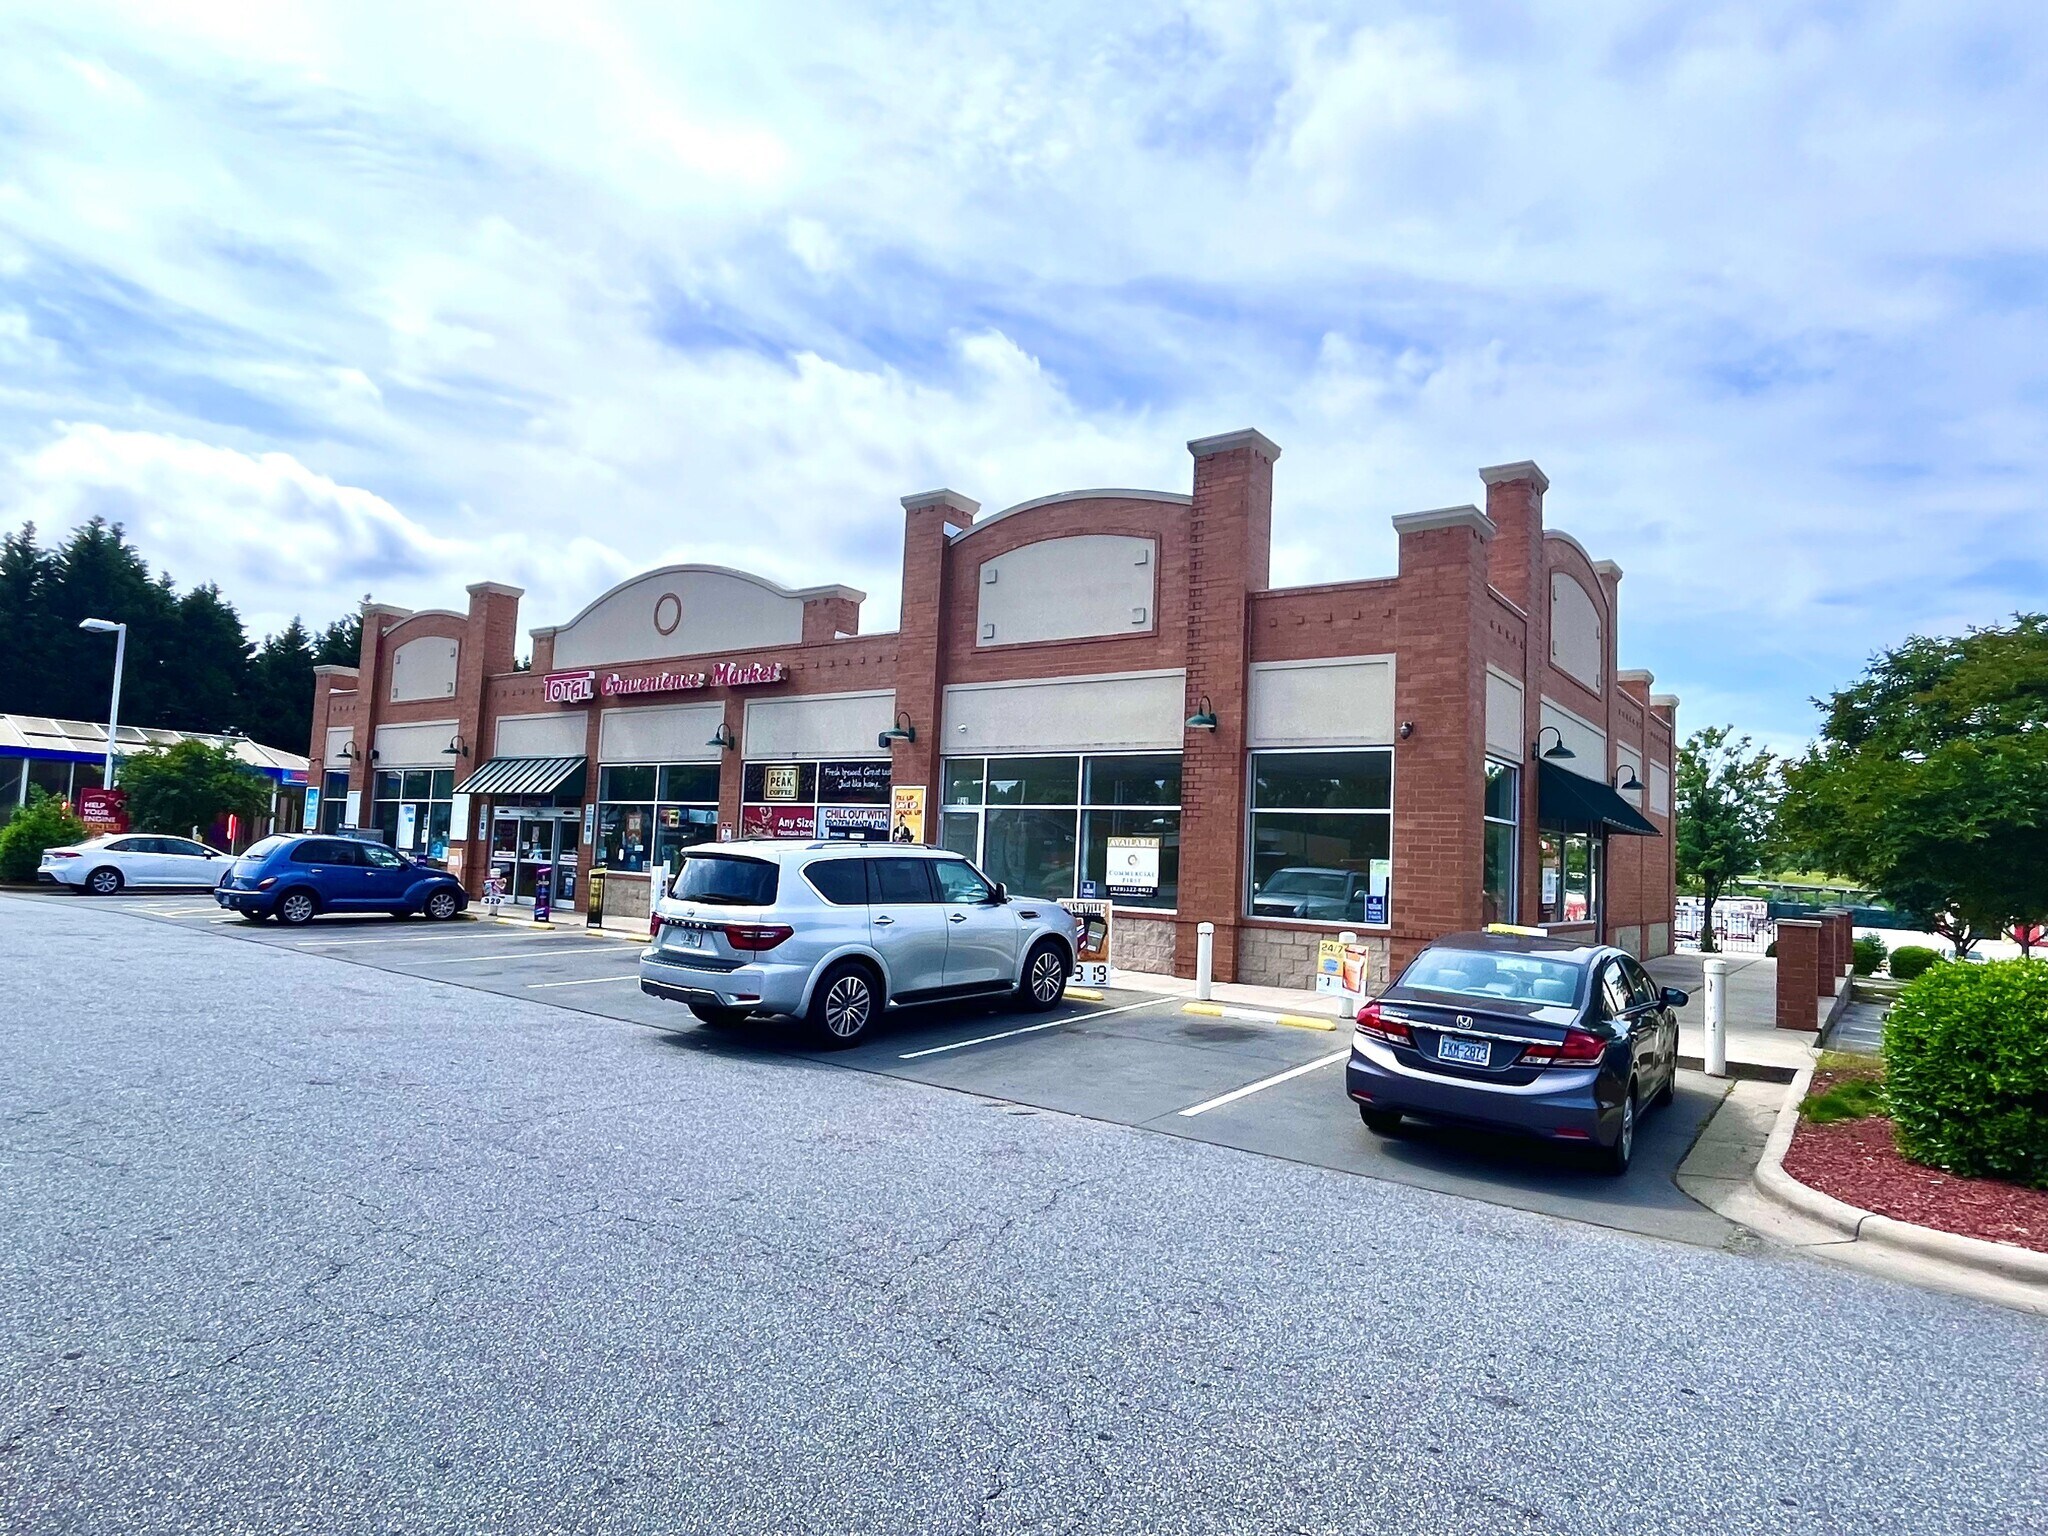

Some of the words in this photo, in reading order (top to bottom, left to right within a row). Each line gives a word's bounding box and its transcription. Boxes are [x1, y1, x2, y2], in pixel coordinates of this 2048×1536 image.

[543, 670, 595, 703] TOTAL
[601, 672, 705, 697] Convenience
[710, 662, 782, 687] Market
[770, 777, 793, 787] PEAK
[825, 809, 847, 819] CHILL
[848, 810, 865, 819] OUT
[866, 810, 888, 819] WITH
[778, 817, 795, 829] Any
[796, 817, 814, 828] Size
[873, 820, 888, 828] FUN
[1109, 838, 1158, 847] AVAILABLE
[1321, 943, 1344, 954] 24/7
